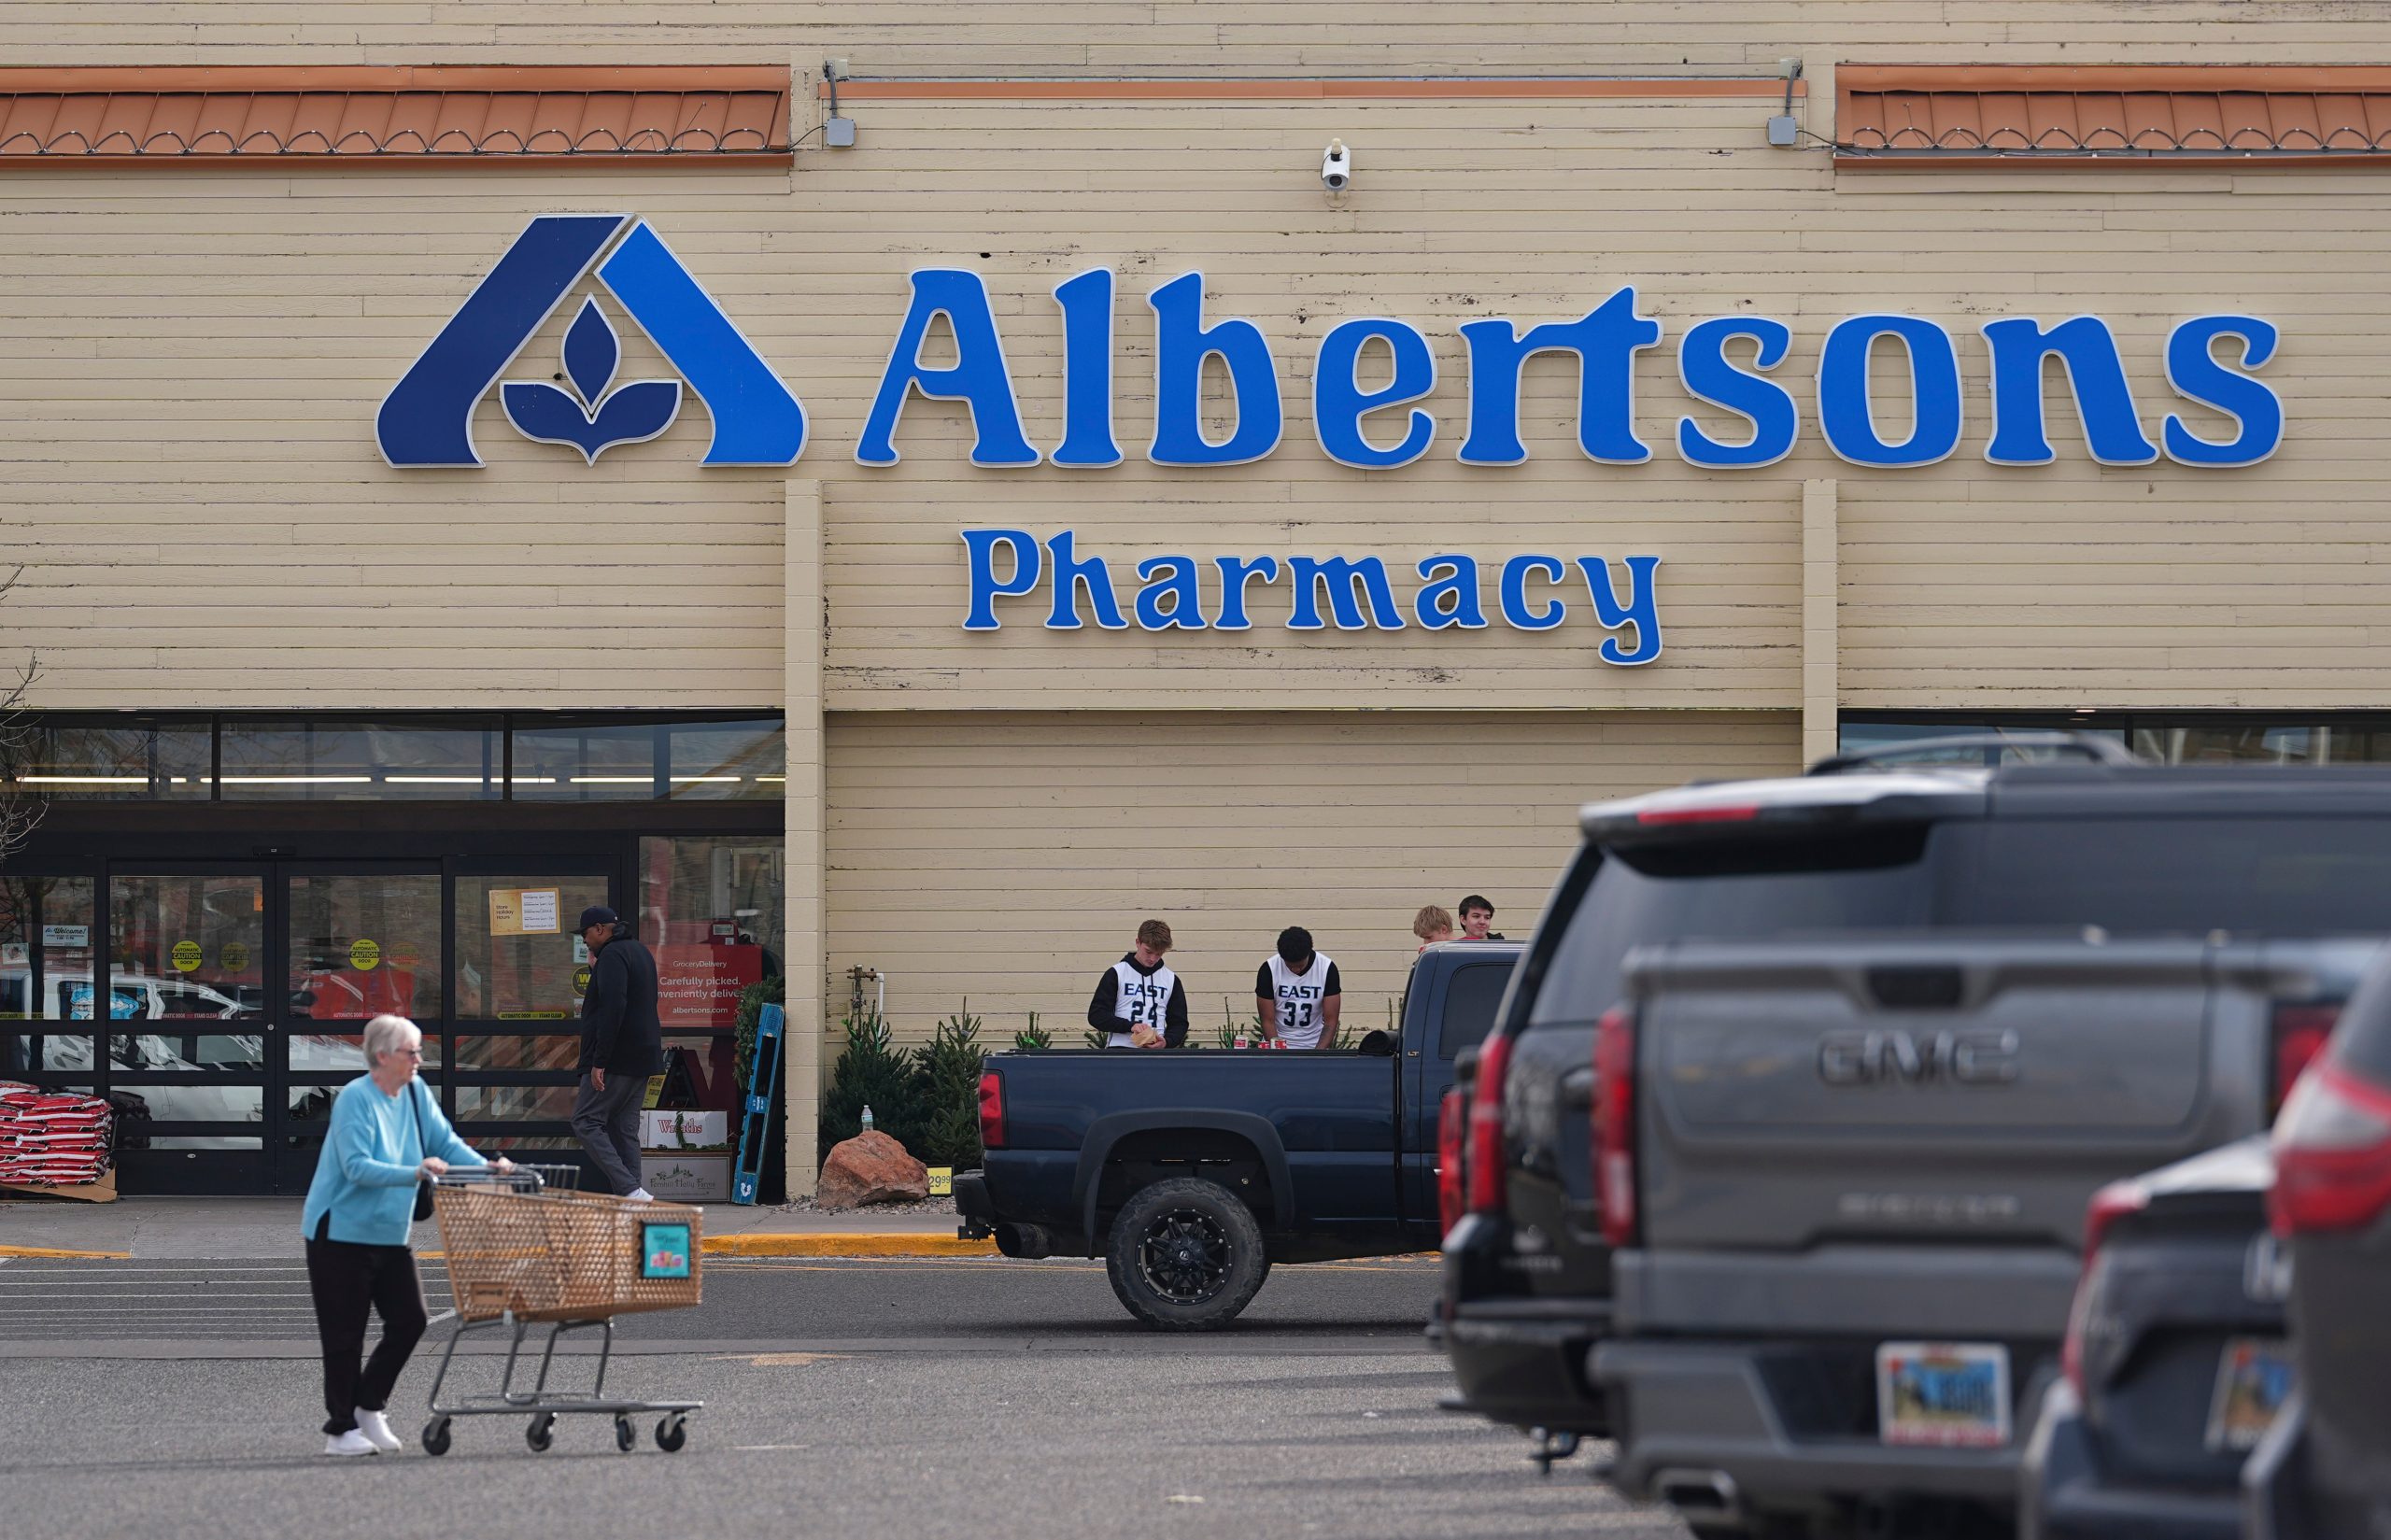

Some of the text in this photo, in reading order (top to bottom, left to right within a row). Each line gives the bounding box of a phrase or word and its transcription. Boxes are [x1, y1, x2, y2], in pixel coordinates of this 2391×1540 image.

[855, 266, 2285, 471] Albertsons
[959, 527, 1664, 668] Pharmacy
[672, 960, 728, 969] GroceryDelivery
[659, 976, 741, 987] Carefully picked.
[1125, 982, 1167, 999] EAST
[1279, 984, 1322, 999] EAST
[658, 989, 708, 1000] nveniently
[1131, 1001, 1158, 1028] 24
[1283, 1001, 1313, 1027] 33
[1819, 1028, 2019, 1084] GMC
